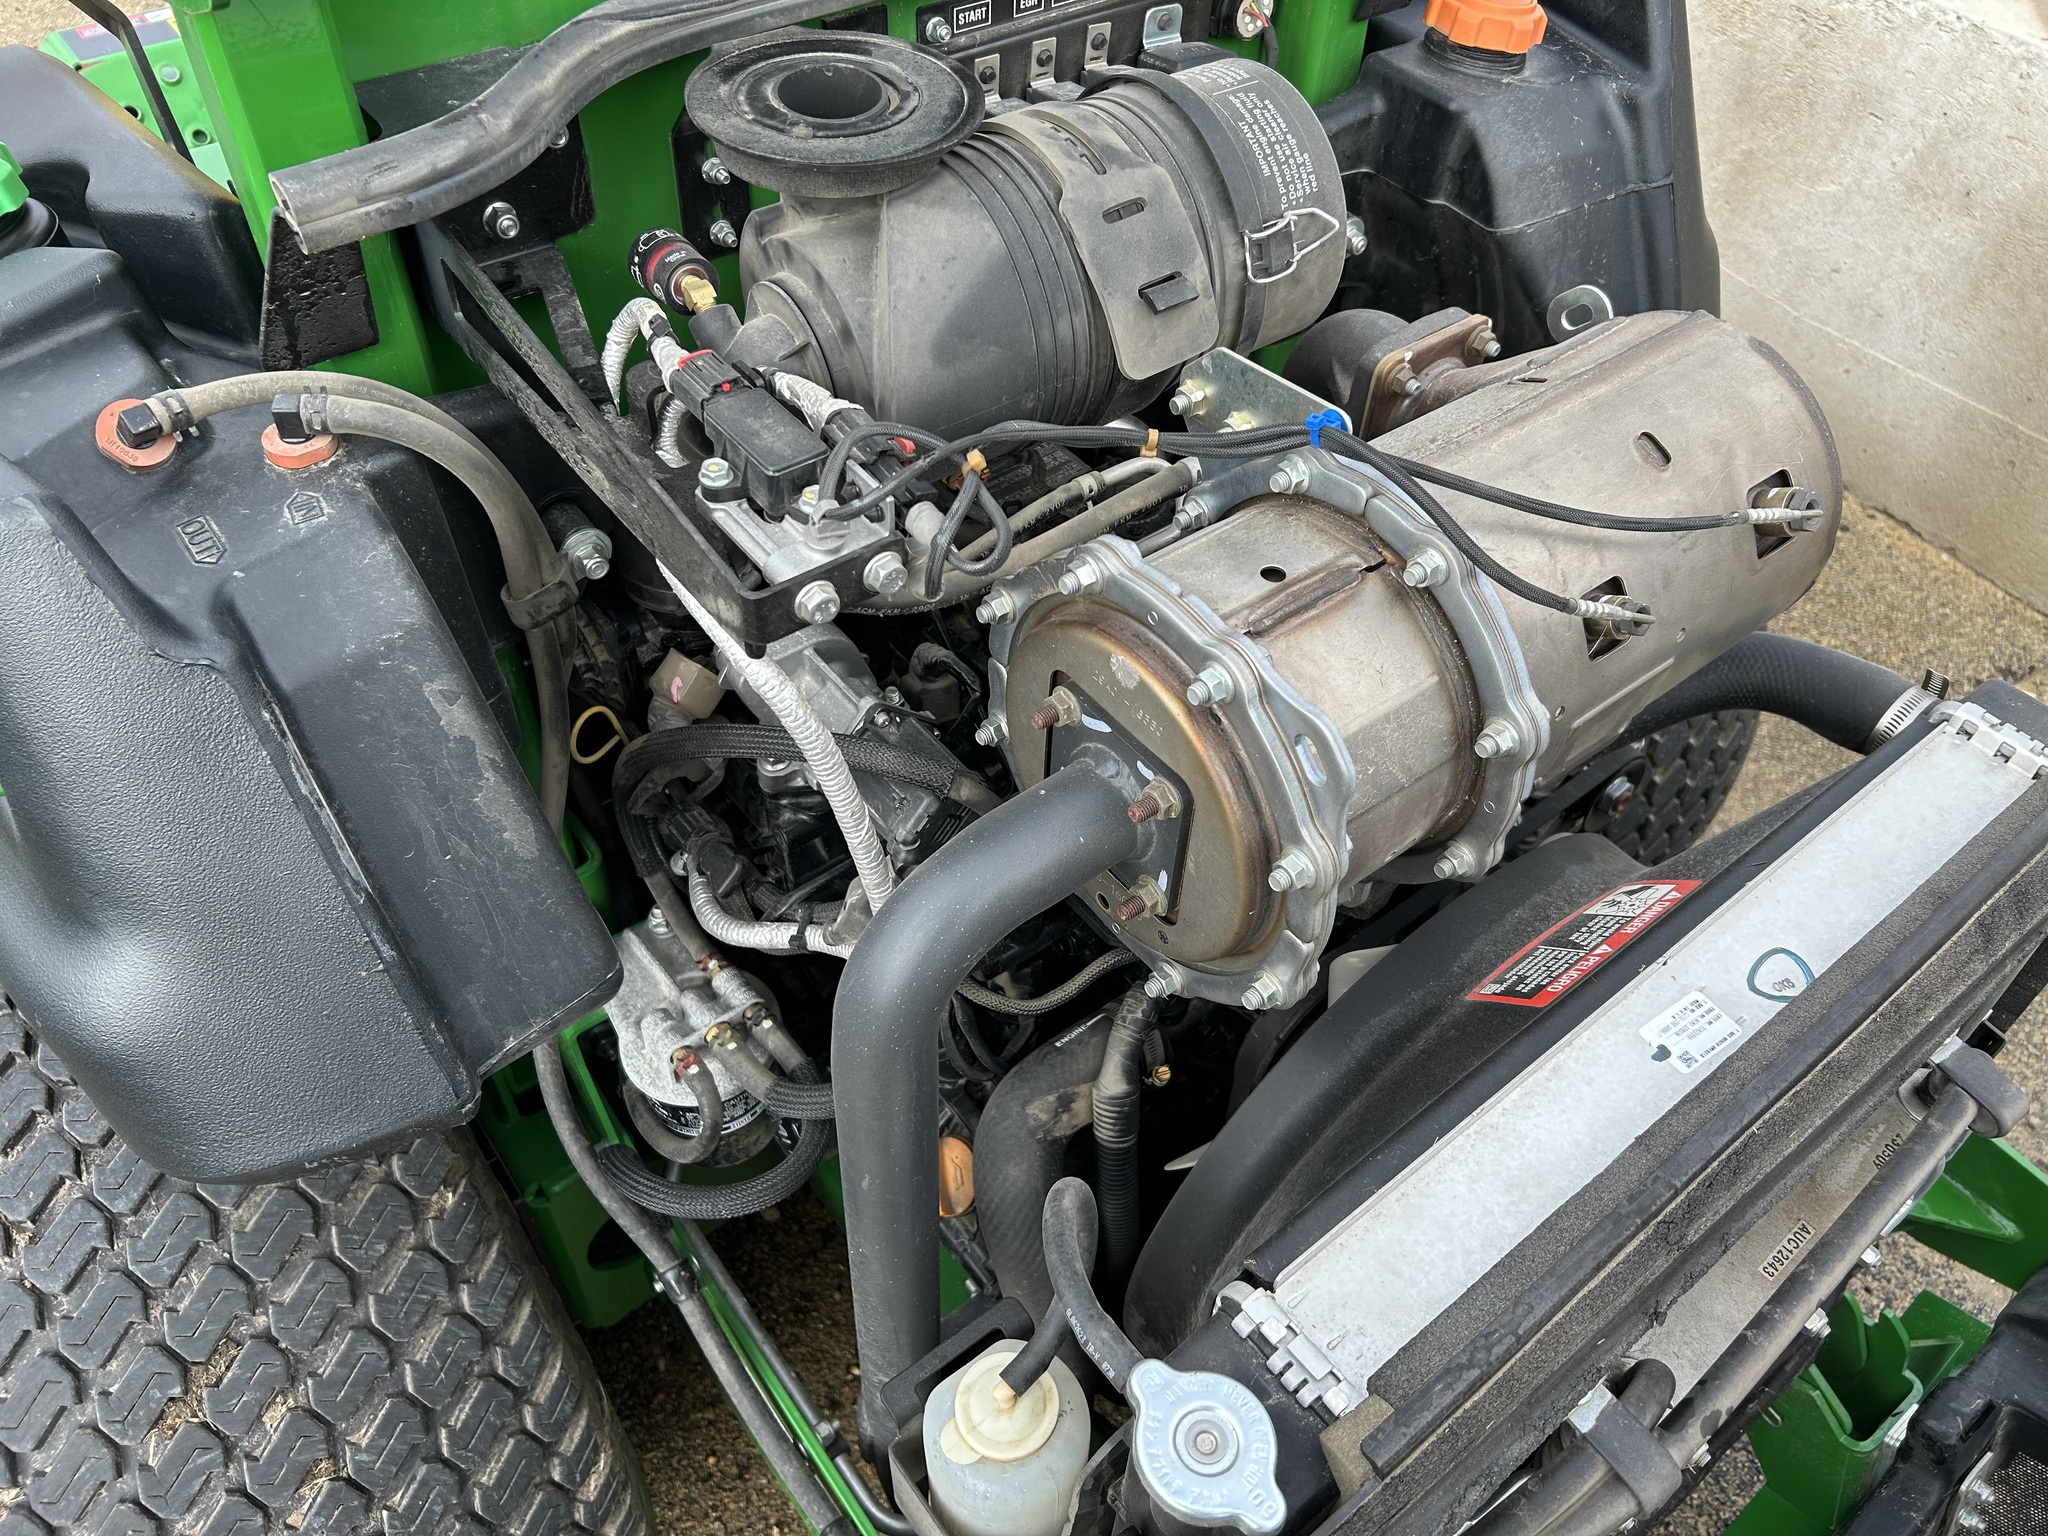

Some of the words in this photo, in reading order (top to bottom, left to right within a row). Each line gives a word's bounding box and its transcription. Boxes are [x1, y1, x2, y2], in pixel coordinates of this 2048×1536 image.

[958, 7, 987, 25] START
[1227, 94, 1253, 124] damage:
[1236, 92, 1256, 110] fluid
[1247, 92, 1264, 108] only
[1253, 109, 1277, 143] starting
[1264, 99, 1288, 133] reaches
[1265, 110, 1285, 141] cleaner
[1238, 121, 1271, 177] IMPORTANT
[1251, 123, 1272, 155] engine
[1281, 143, 1292, 157] air
[1286, 133, 1304, 164] gauge
[1274, 145, 1286, 163] use
[1303, 152, 1314, 172] line
[1270, 154, 1287, 194] prevent
[1281, 165, 1292, 182] not
[1289, 158, 1304, 197] Service
[1298, 166, 1311, 195] when
[1309, 174, 1319, 193] red
[1281, 196, 1289, 211] To
[1288, 185, 1297, 200] Do
[293, 501, 318, 521] IN
[1114, 514, 1132, 528] FKM
[181, 519, 220, 561] OUT
[1618, 900, 1671, 934] DANGER
[1545, 954, 1601, 992] PELIGRO
[1054, 1024, 1089, 1047] ENGINE
[1763, 1223, 1812, 1278] AUC12643
